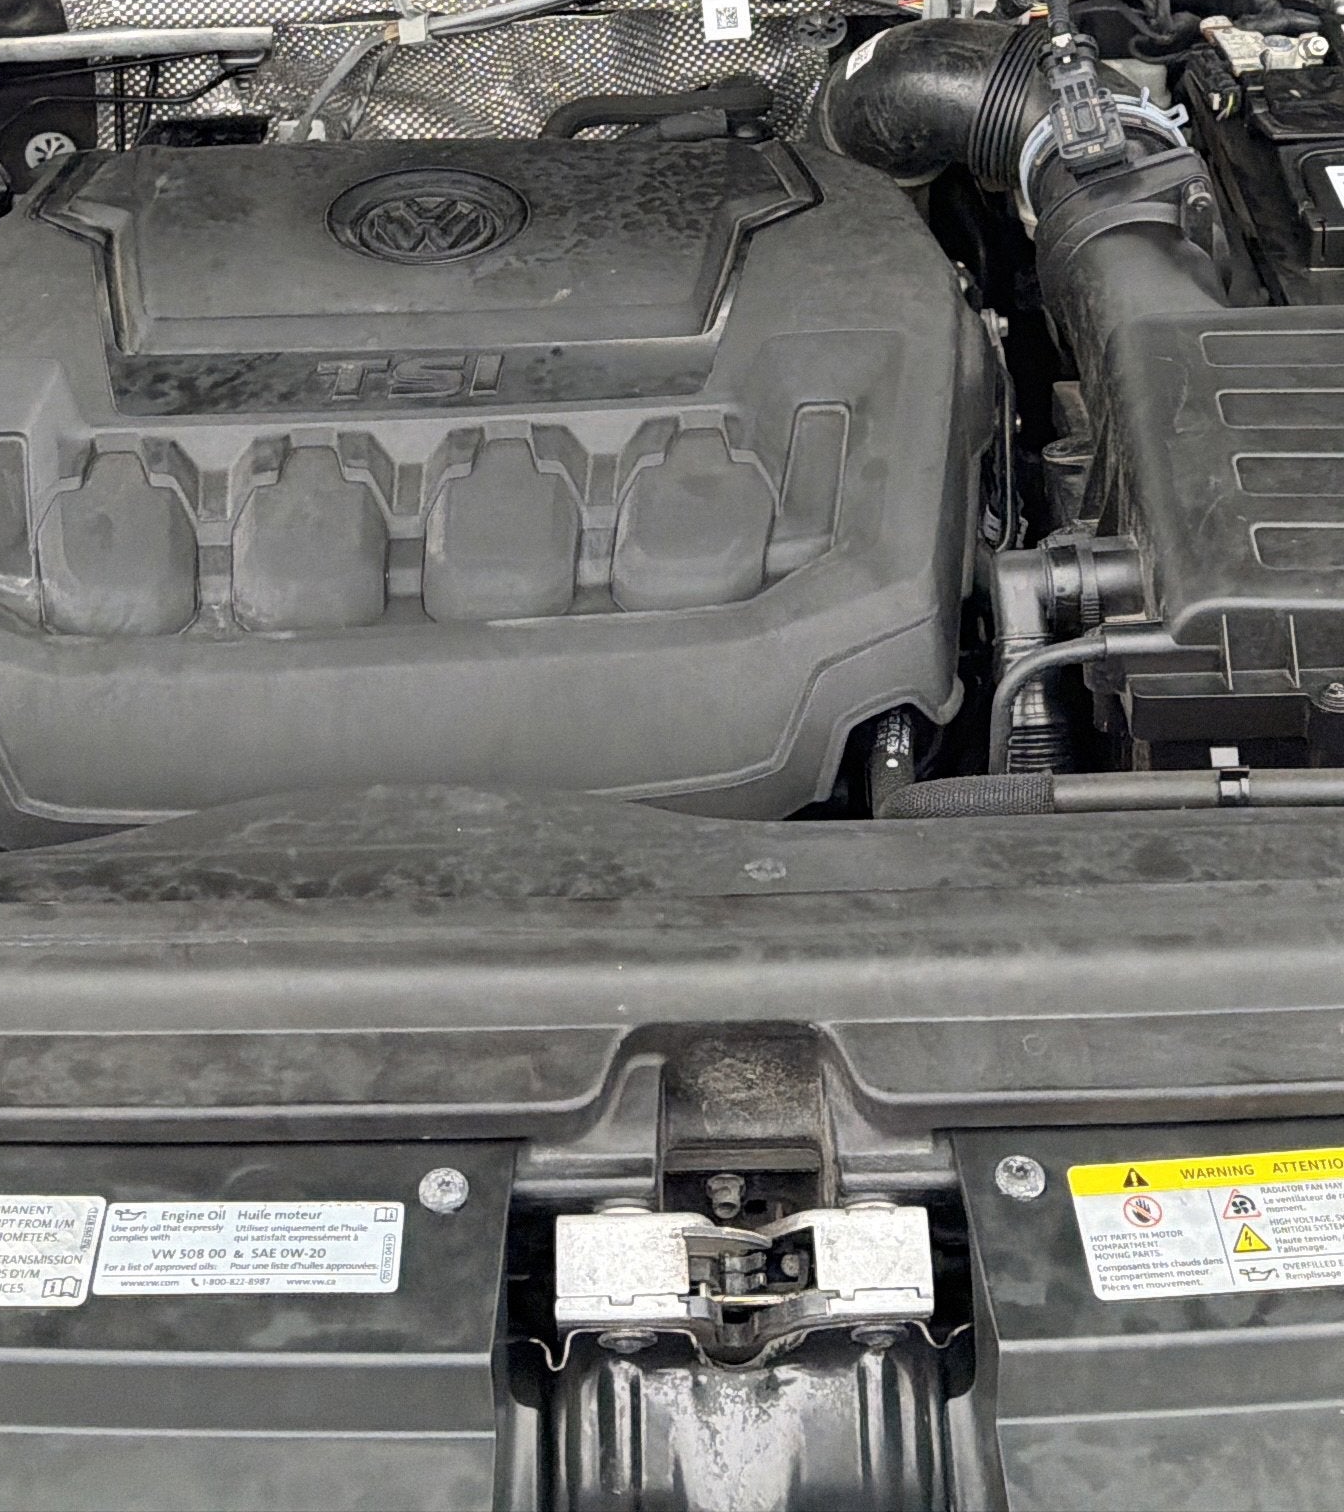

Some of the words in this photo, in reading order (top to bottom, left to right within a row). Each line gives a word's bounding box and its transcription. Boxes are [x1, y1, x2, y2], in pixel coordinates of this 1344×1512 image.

[316, 352, 505, 401] TSI
[1179, 1163, 1255, 1180] WARNING
[1259, 1183, 1305, 1195] RADIATOR
[1304, 1182, 1324, 1191] FAN
[1323, 1181, 1343, 1190] MAY
[1261, 1196, 1274, 1205] Le
[1274, 1193, 1324, 1204] ventilateur
[1324, 1192, 1337, 1201] de
[160, 1209, 205, 1224] Engine
[206, 1209, 227, 1221] Oil
[236, 1208, 272, 1221] Huile
[273, 1209, 323, 1221] moteur
[1268, 1216, 1292, 1227] HIGH
[1291, 1213, 1335, 1226] VOLTAGE,
[16, 1218, 53, 1229] FROM
[53, 1218, 76, 1229] I/M
[110, 1224, 129, 1233] Use
[128, 1223, 150, 1234] only
[148, 1223, 162, 1232] oil
[161, 1223, 182, 1234] that
[181, 1223, 225, 1234] expressly
[234, 1223, 270, 1233] Utilisez
[269, 1223, 326, 1234] uniquement
[326, 1223, 340, 1232] de
[339, 1223, 369, 1233] l'huile
[107, 1233, 149, 1244] complies
[149, 1233, 171, 1242] with
[232, 1233, 249, 1244] qui
[249, 1232, 287, 1242] satisfait
[287, 1232, 352, 1244] expressément
[352, 1232, 359, 1242] à
[1088, 1233, 1108, 1243] HOT
[1109, 1231, 1138, 1242] PARTS
[1138, 1231, 1150, 1239] IN
[1149, 1228, 1184, 1239] MOTOR
[1273, 1236, 1303, 1245] Haute
[1303, 1233, 1342, 1243] tension,
[151, 1248, 177, 1260] VW
[178, 1247, 205, 1260] 508
[207, 1247, 227, 1259] 00
[232, 1248, 245, 1259] &
[250, 1247, 277, 1259] SAE
[279, 1247, 327, 1259] 0W-20
[1093, 1250, 1131, 1261] MOVING
[1131, 1249, 1163, 1259] PARTS.
[102, 1262, 119, 1272] For
[118, 1263, 126, 1272] a
[126, 1261, 142, 1272] list
[142, 1261, 154, 1272] of
[153, 1261, 198, 1273] approved
[197, 1261, 218, 1271] oils:
[228, 1261, 252, 1270] Pour
[251, 1262, 270, 1270] une
[269, 1261, 290, 1270] liste
[289, 1260, 325, 1270] d'huiles
[324, 1260, 380, 1272] approuvées:
[1096, 1261, 1152, 1273] Composants
[1150, 1260, 1170, 1270] très
[1169, 1258, 1202, 1268] chauds
[1201, 1257, 1225, 1266] dans
[1281, 1259, 1337, 1271] OVERFILLED
[8, 1268, 41, 1279] D'I/M
[1098, 1273, 1108, 1282] le
[1108, 1269, 1175, 1282] compartiment
[286, 1278, 336, 1286] www.vw.ca
[1100, 1282, 1131, 1292] Pièces
[1131, 1282, 1145, 1291] en
[1144, 1278, 1204, 1289] mouvement.
